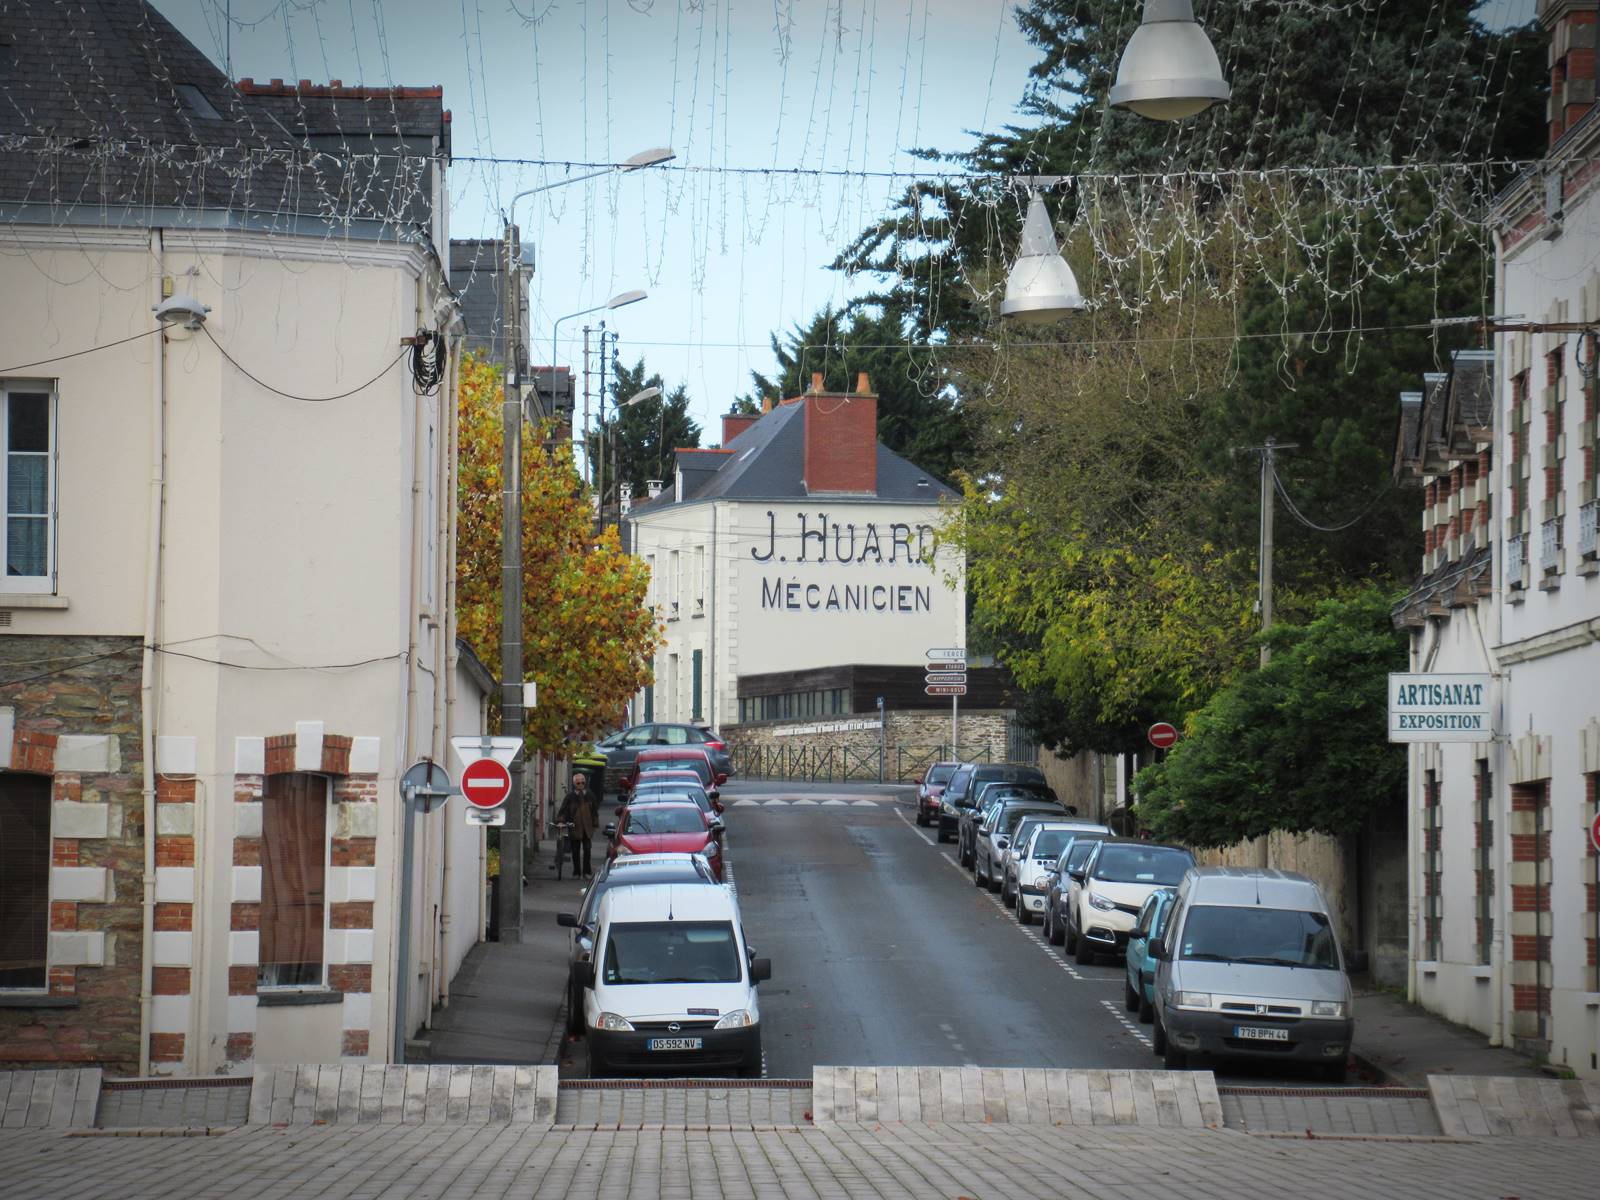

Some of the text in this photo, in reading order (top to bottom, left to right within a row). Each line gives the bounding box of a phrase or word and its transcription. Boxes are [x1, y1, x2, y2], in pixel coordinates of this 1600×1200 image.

[751, 510, 938, 563] J. HUARD
[762, 576, 930, 611] MÉCANICIEN
[1397, 684, 1483, 705] ARTISANAT
[1399, 715, 1482, 728] EXPOSITION
